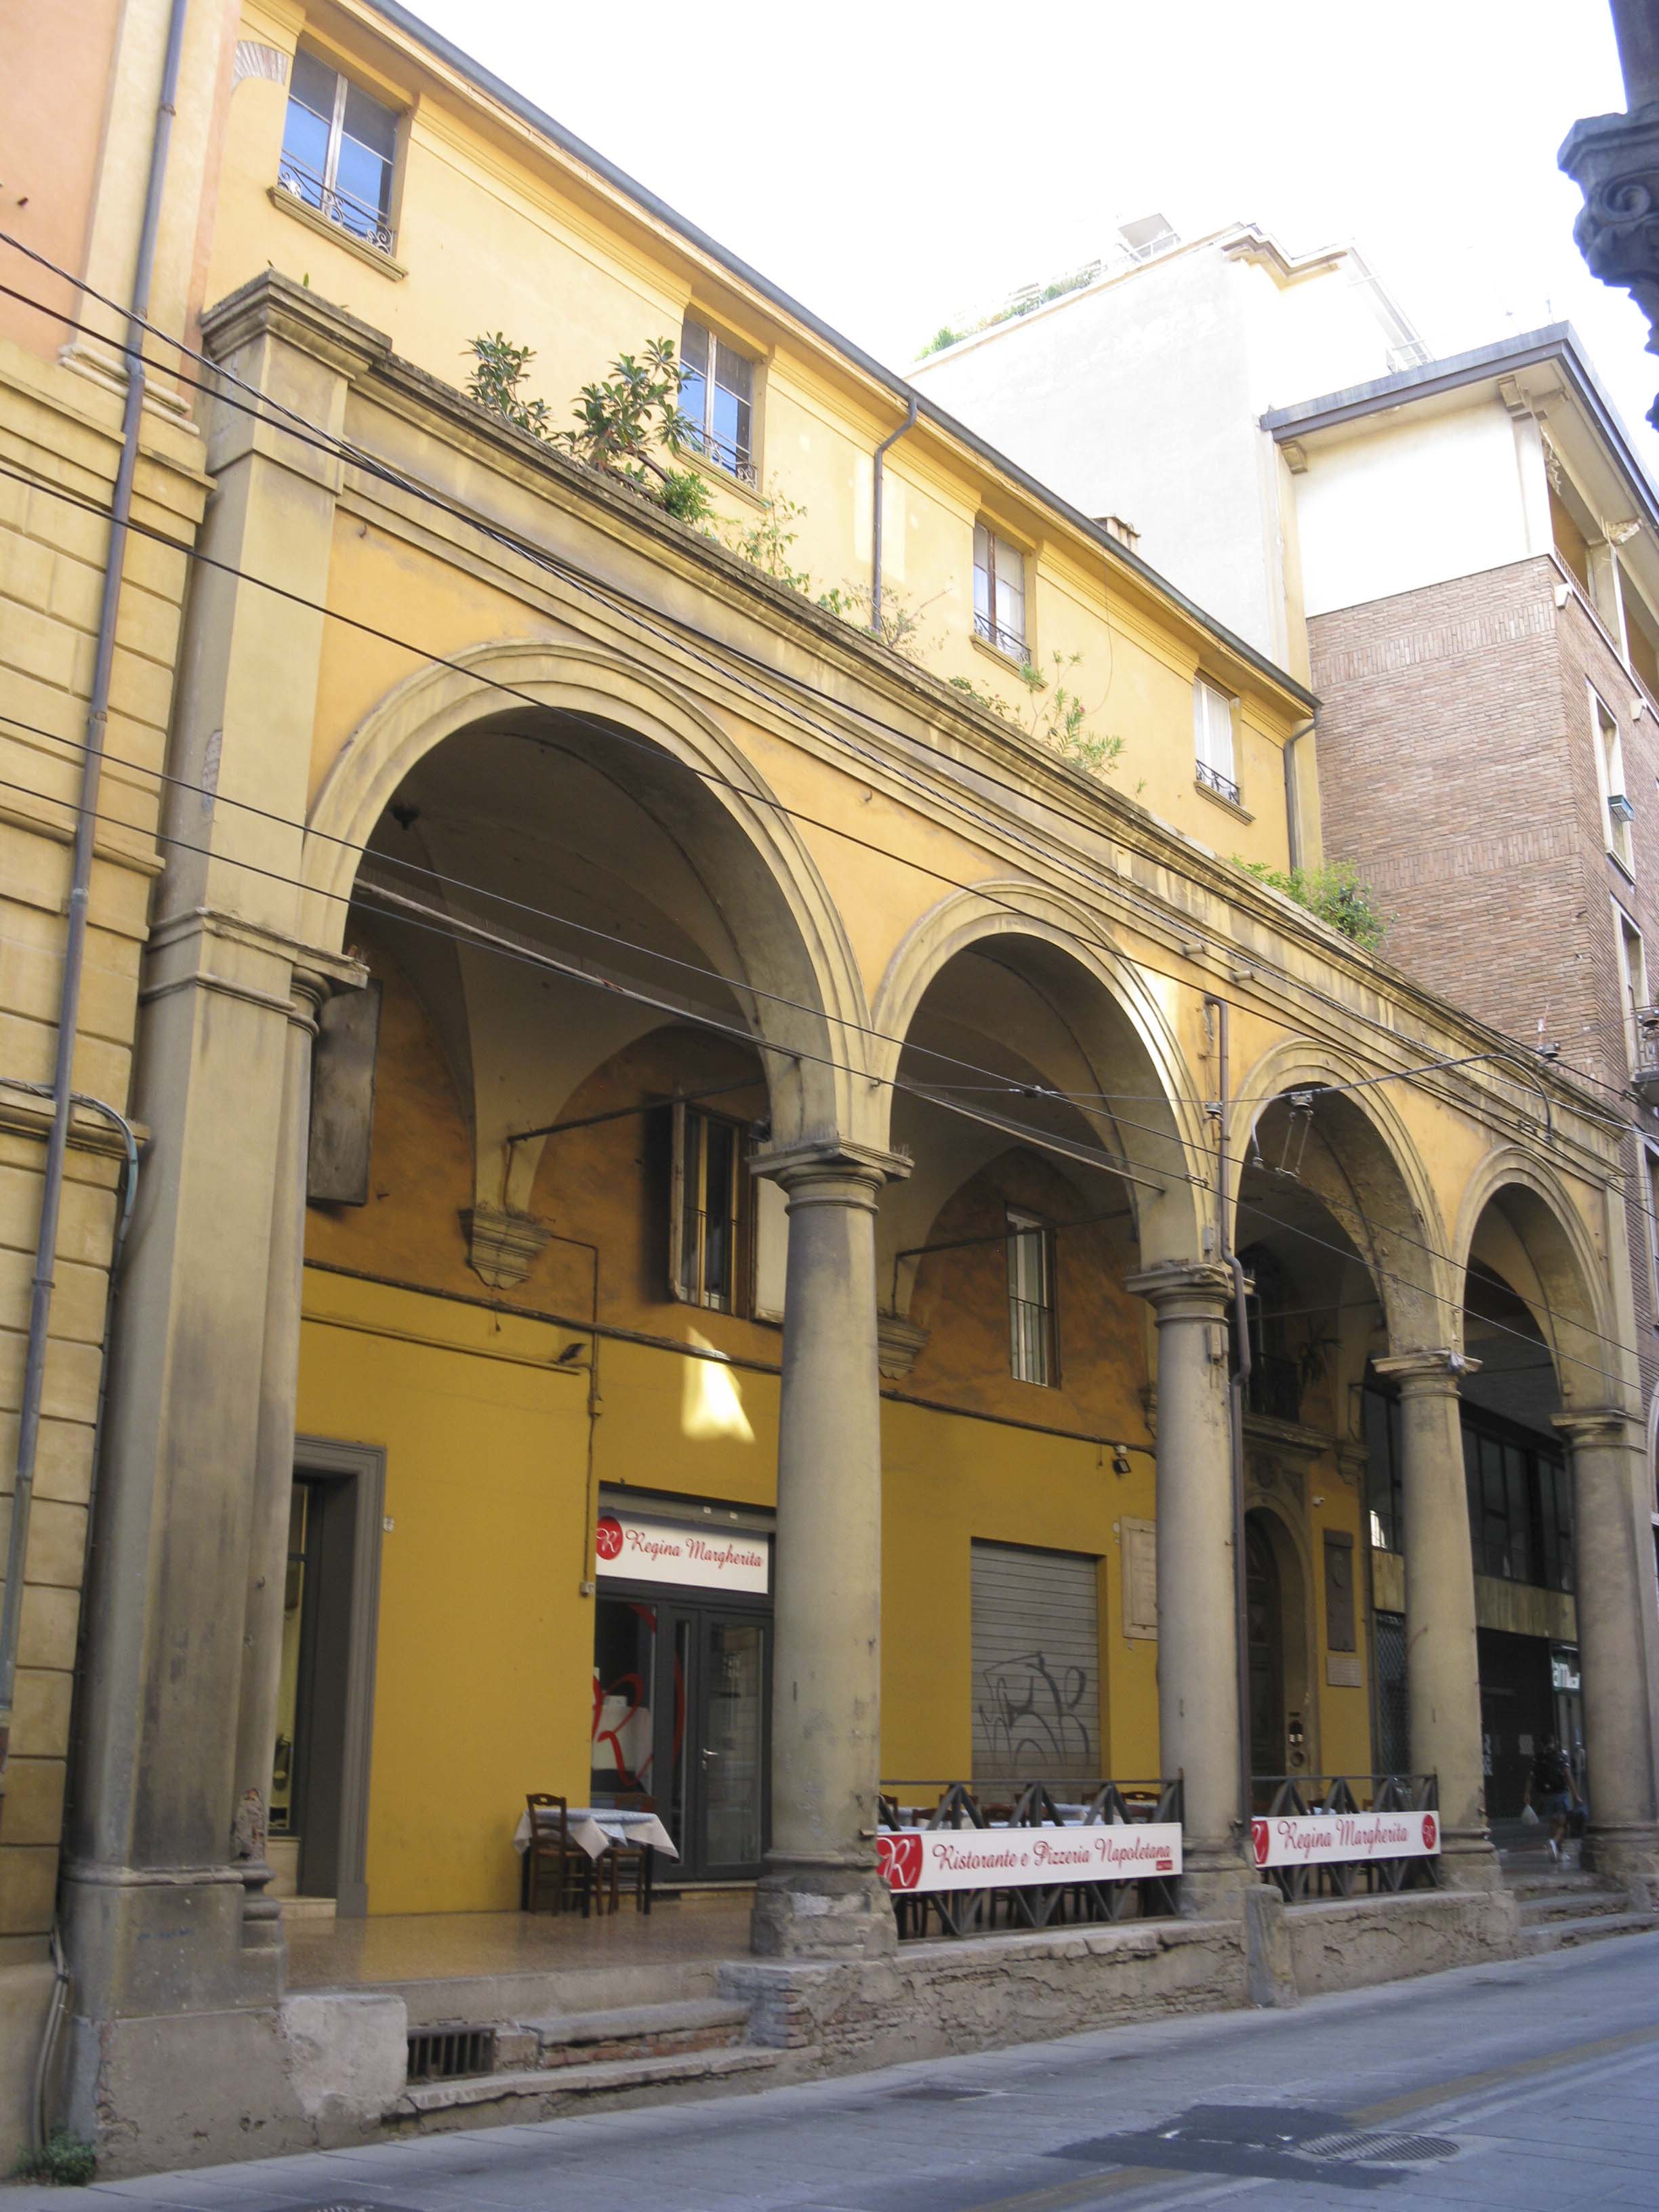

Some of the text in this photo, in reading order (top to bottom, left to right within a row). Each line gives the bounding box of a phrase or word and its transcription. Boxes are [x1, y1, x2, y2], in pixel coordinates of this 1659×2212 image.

[626, 1529, 682, 1561] Regina
[686, 1538, 762, 1570] Margherita
[933, 1843, 1017, 1870] Ristorante
[1020, 1853, 1029, 1867] e
[1033, 1840, 1090, 1866] Pizzeria
[1094, 1836, 1172, 1869] Napoletana
[1277, 1820, 1332, 1859] Regina
[1335, 1816, 1408, 1854] Margherita
